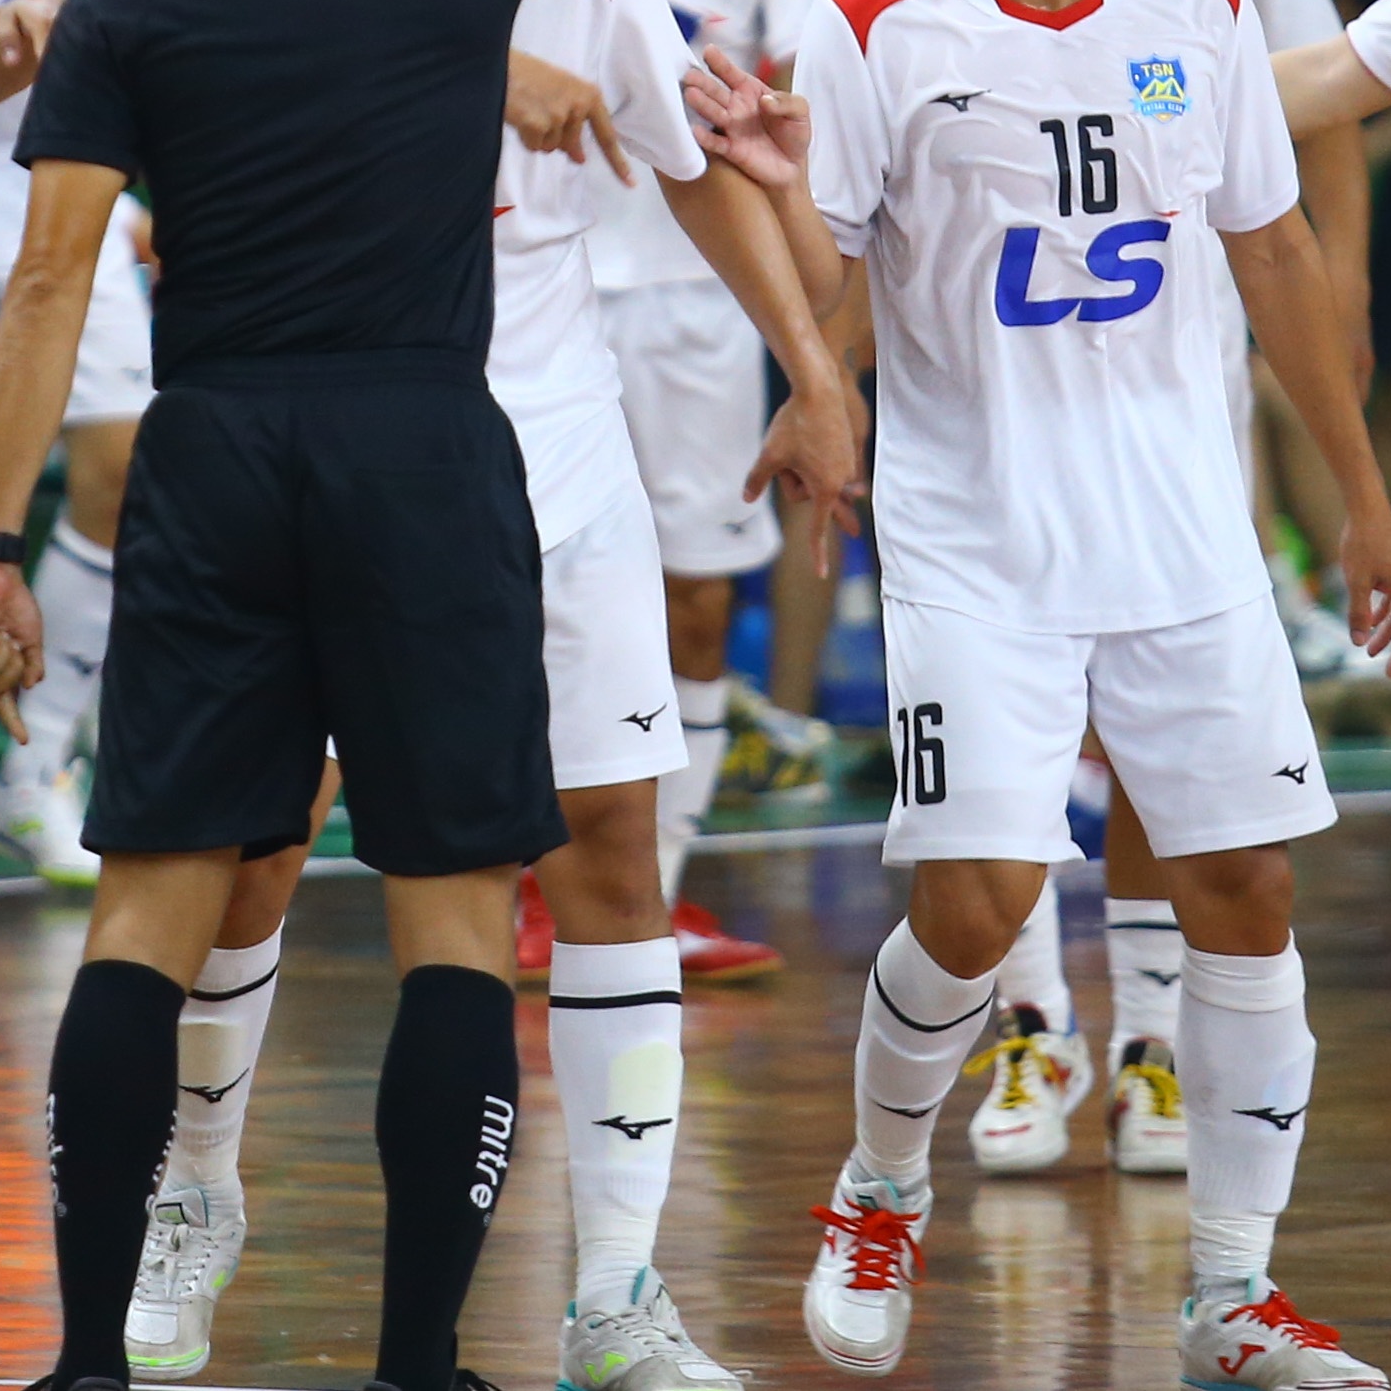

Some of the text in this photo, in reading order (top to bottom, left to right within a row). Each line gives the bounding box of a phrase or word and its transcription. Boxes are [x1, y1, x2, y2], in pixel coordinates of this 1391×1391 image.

[1140, 63, 1175, 78] TSN
[1040, 114, 1118, 217] 16
[995, 219, 1171, 327] LS
[897, 702, 946, 807] 16
[469, 1094, 515, 1209] mitre
